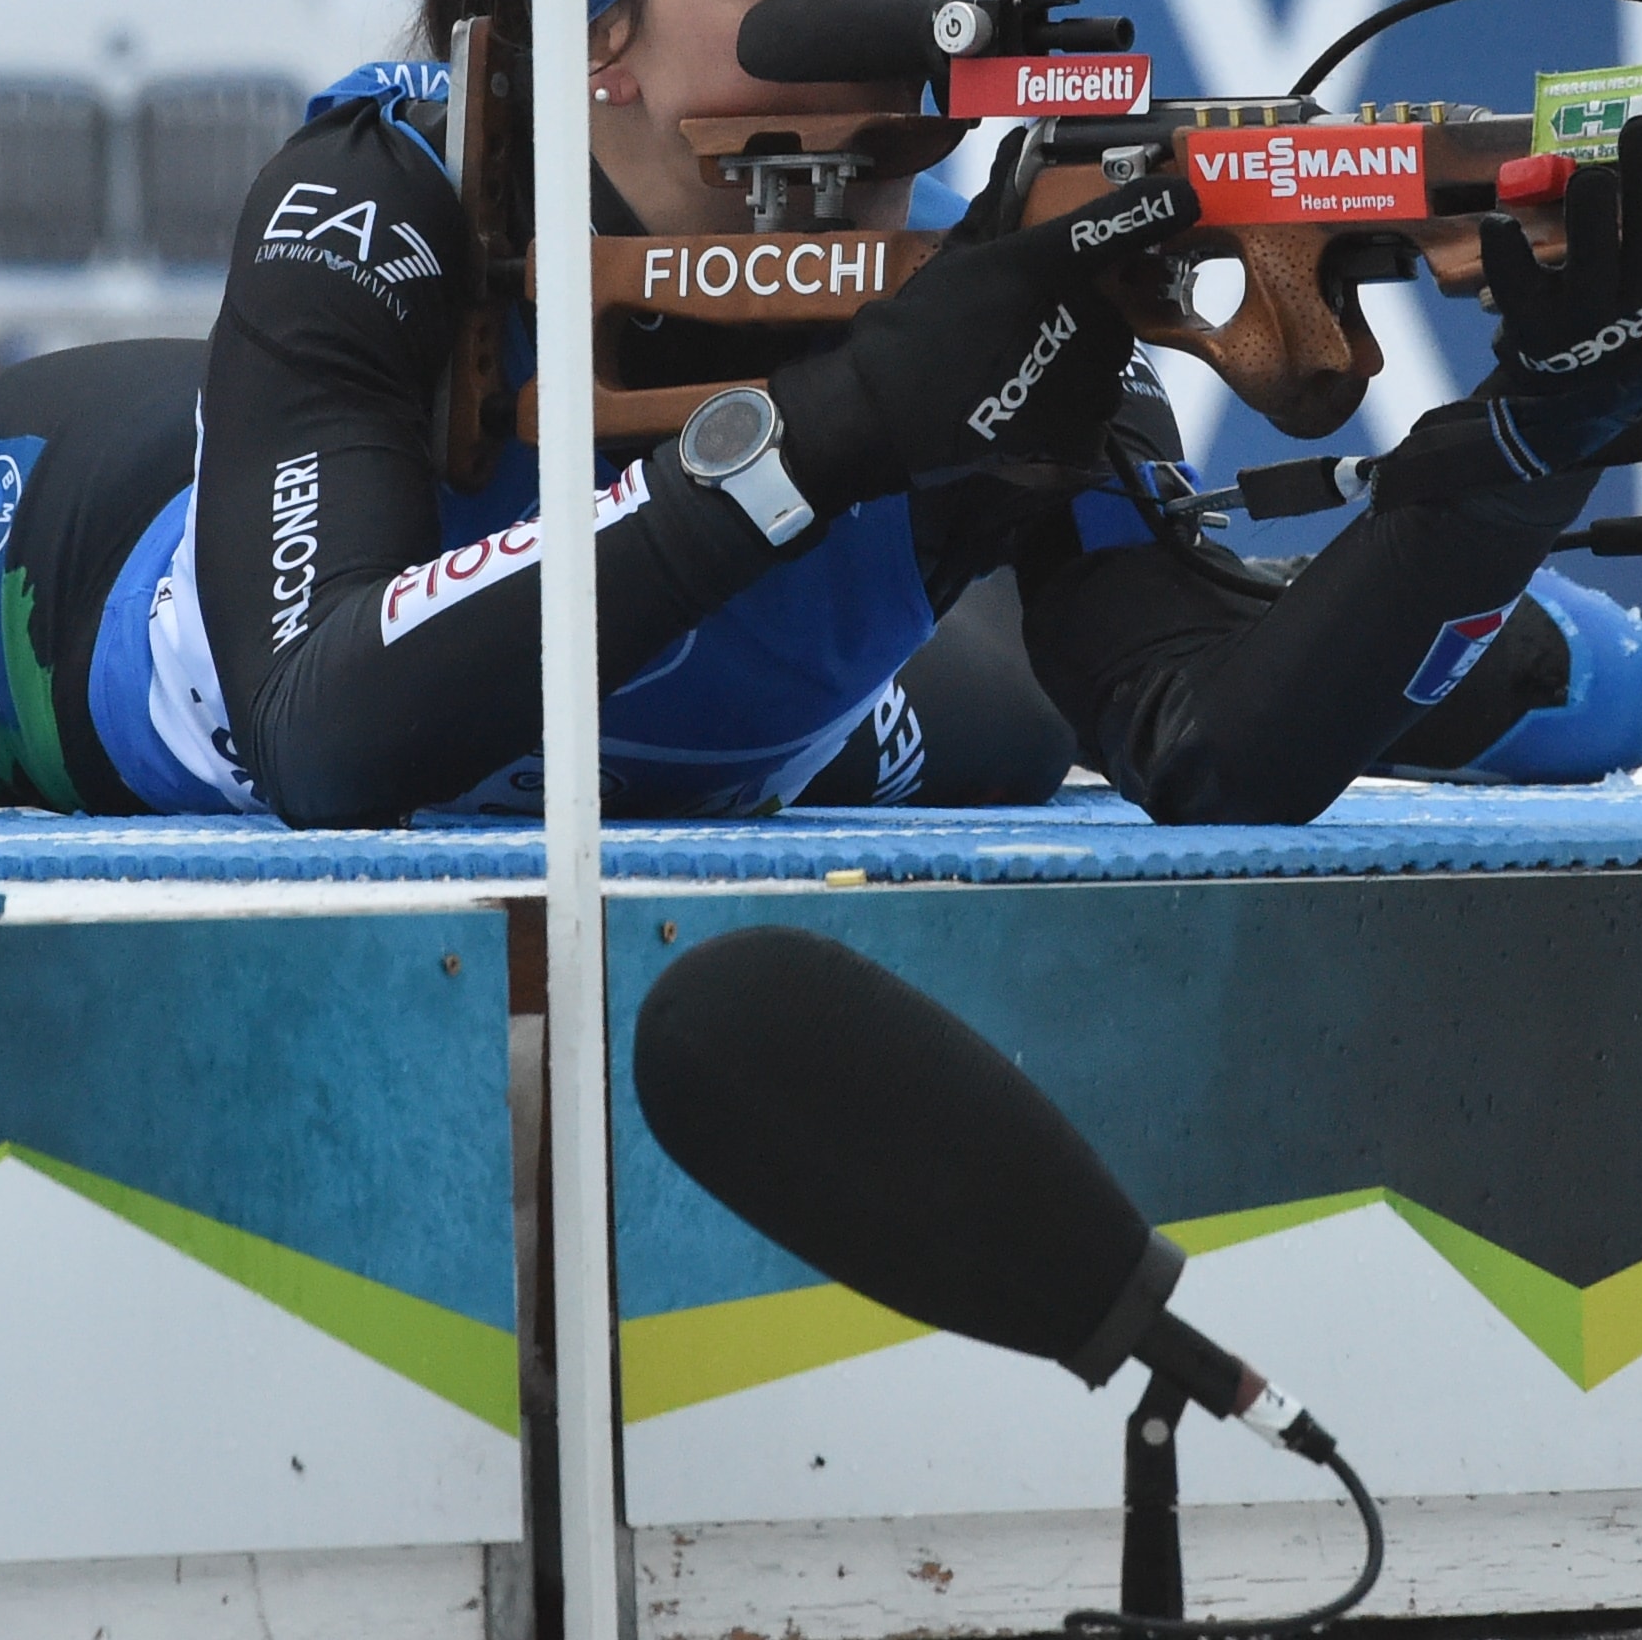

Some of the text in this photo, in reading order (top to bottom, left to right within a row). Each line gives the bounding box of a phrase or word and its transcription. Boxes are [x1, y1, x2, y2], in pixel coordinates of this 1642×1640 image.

[1016, 65, 1134, 106] felicetti
[1065, 66, 1100, 75] PASTA
[1194, 136, 1418, 198] VIESSMANN
[1300, 192, 1395, 213] Heat pumps
[254, 241, 324, 264] EMPORIO
[644, 241, 886, 299] FIOCCHI
